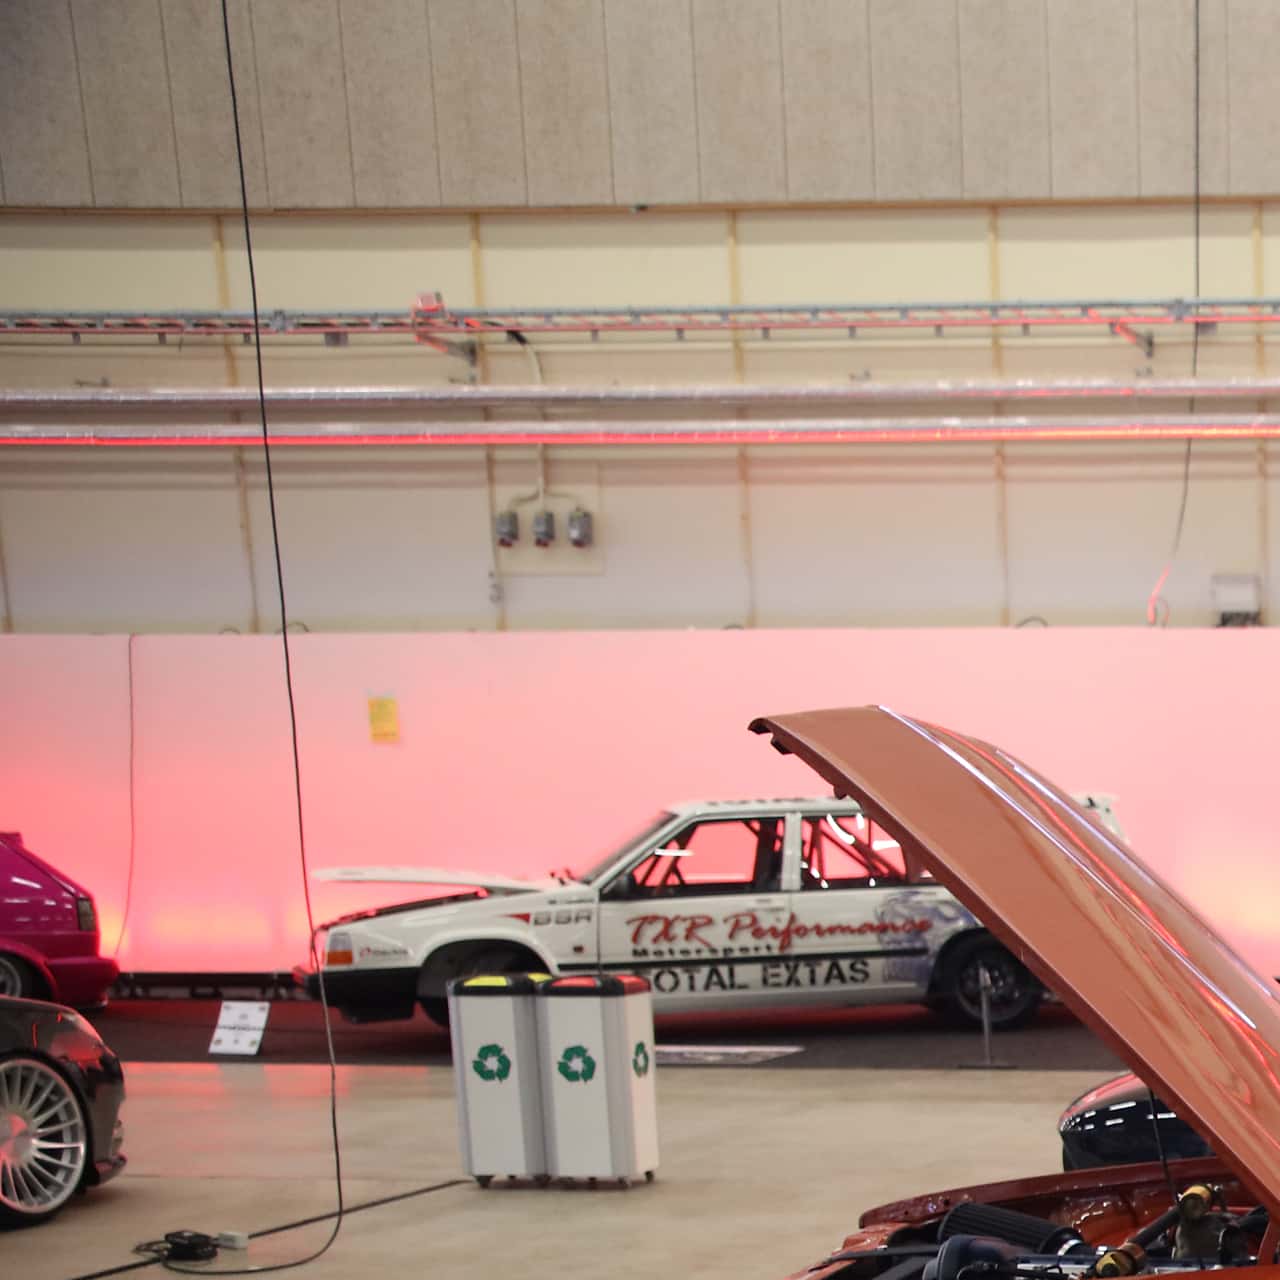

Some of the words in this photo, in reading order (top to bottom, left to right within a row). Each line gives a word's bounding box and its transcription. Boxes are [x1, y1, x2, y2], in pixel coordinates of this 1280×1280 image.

[627, 914, 713, 948] TXR
[724, 912, 933, 952] Performance
[632, 945, 772, 958] Motorsport
[762, 959, 870, 987] EXTAS
